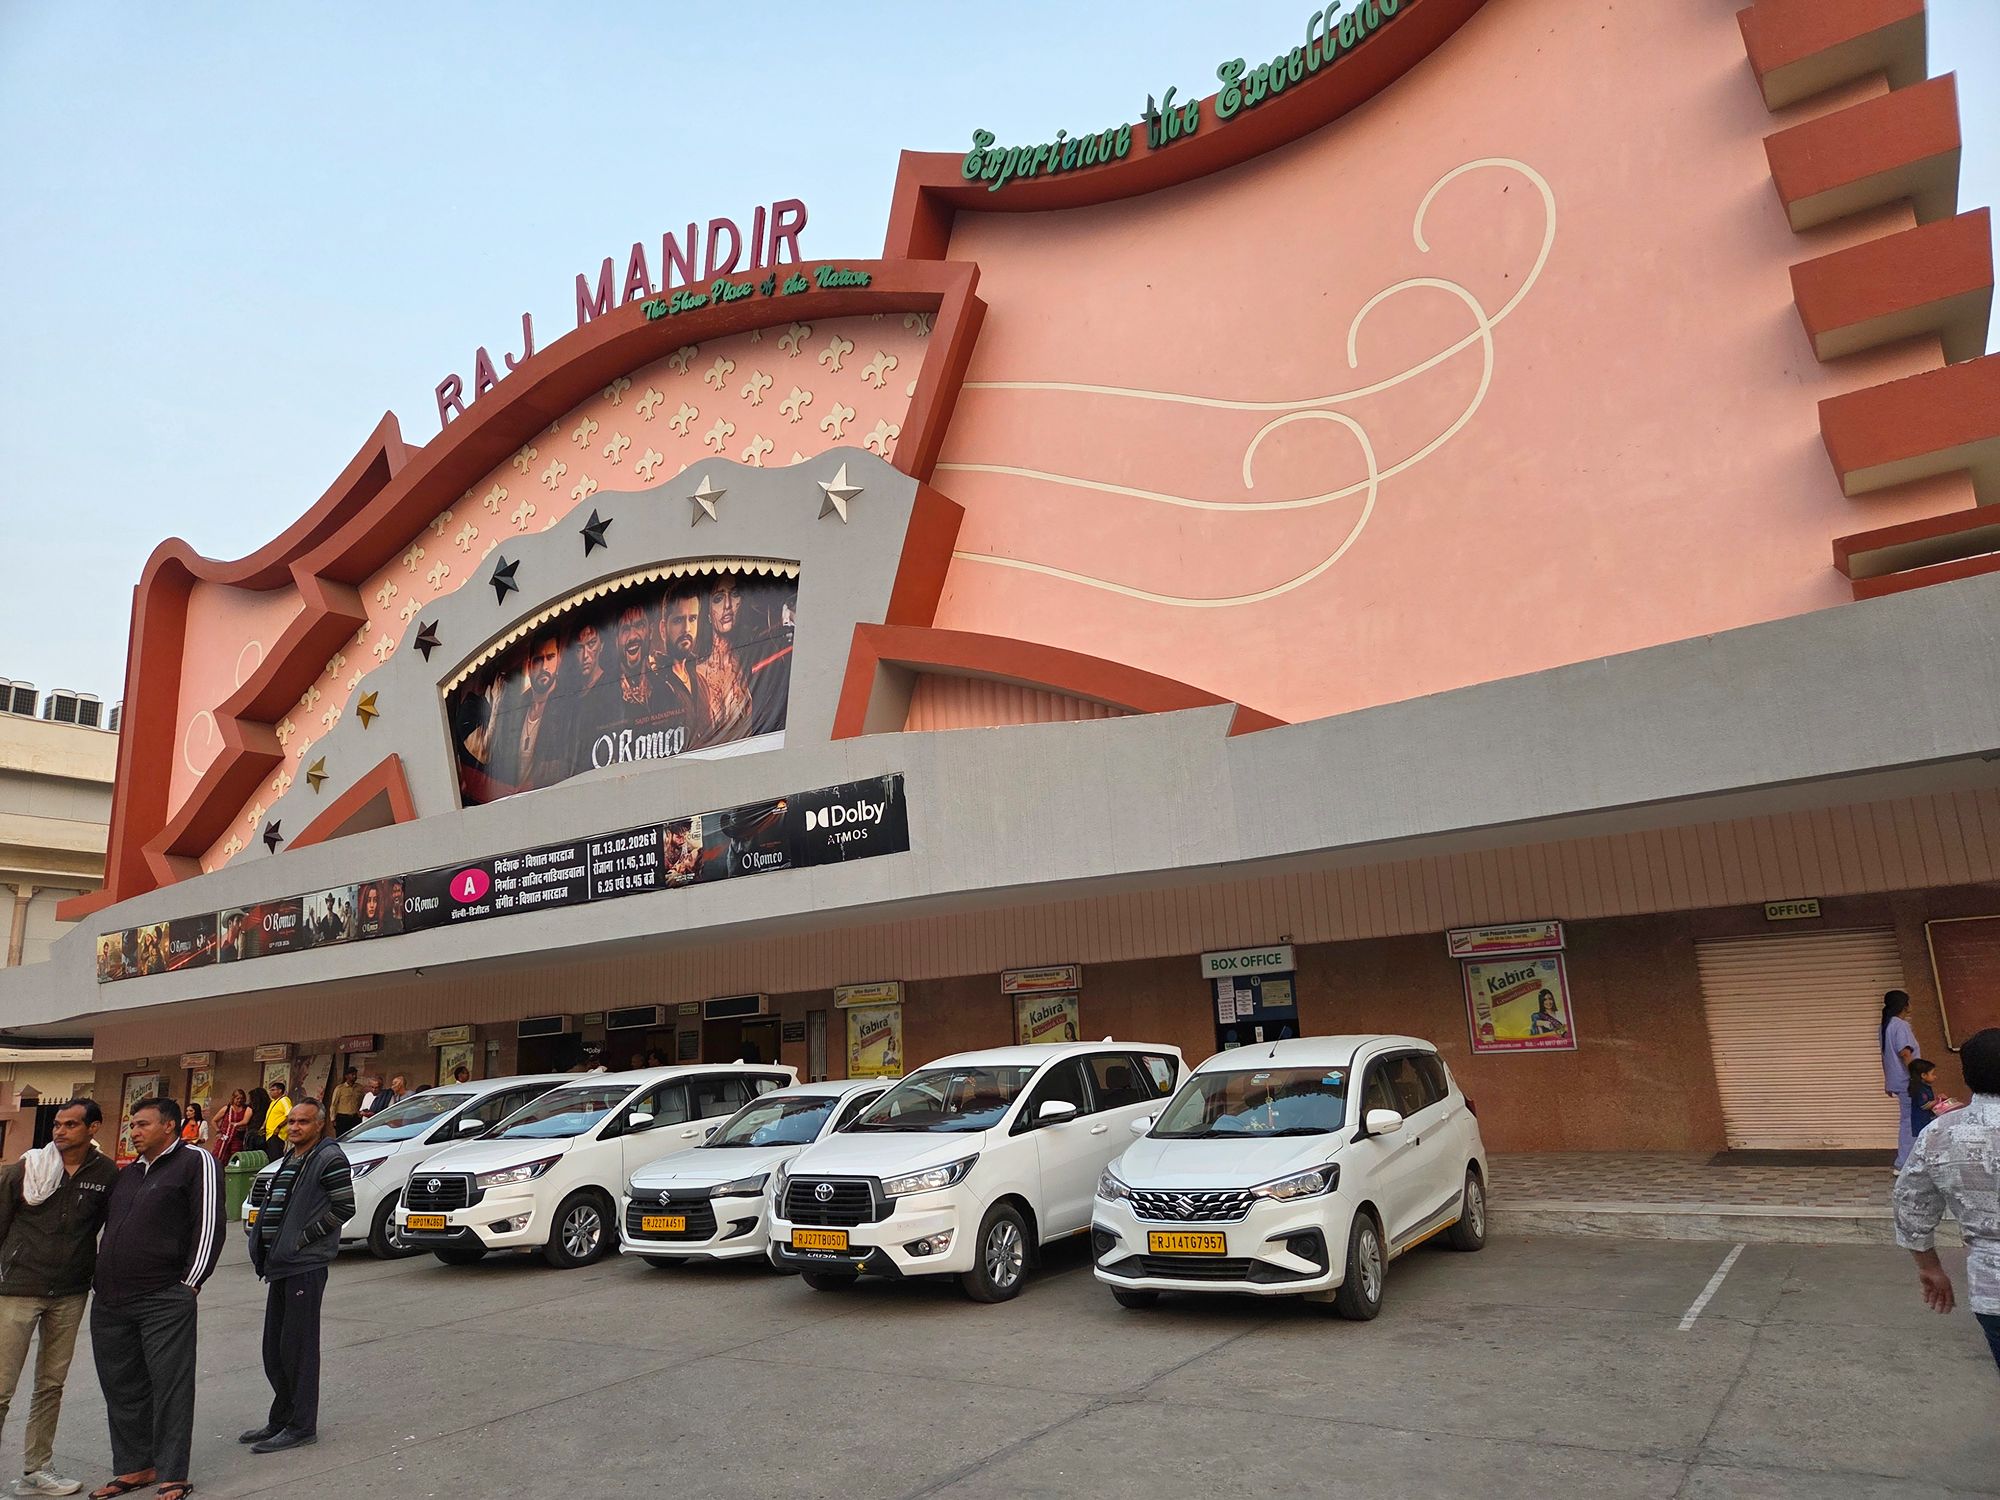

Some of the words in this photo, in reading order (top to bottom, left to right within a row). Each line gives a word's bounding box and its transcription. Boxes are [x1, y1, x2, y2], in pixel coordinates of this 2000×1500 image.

[961, 123, 1132, 192] Experience
[1140, 86, 1200, 149] the
[640, 297, 669, 321] The
[669, 290, 708, 315] Show
[710, 278, 754, 306] Place
[758, 272, 777, 297] of
[782, 273, 809, 297] the
[813, 264, 873, 288] Nation
[435, 313, 535, 431] RAJ
[575, 198, 809, 329] MANDIR
[591, 725, 686, 770] O'Romeo
[831, 799, 886, 827] Dolby
[827, 828, 869, 847] ATMOS
[592, 859, 614, 876] रोजाना
[741, 850, 784, 870] O'Romeo
[463, 876, 476, 896] A
[597, 879, 614, 894] 6.25
[625, 873, 643, 890] 9.45
[404, 892, 440, 914] O'Romeo
[1768, 903, 1817, 917] OFFICE
[263, 911, 297, 932] O'Romeo
[1210, 957, 1238, 970] BOX
[1240, 953, 1282, 968] OFFICE
[1486, 966, 1536, 994] Kabira
[1029, 1003, 1064, 1026] Kabira
[859, 1018, 889, 1039] Kabira
[798, 1233, 846, 1247] RJ27TB0507
[1157, 1236, 1223, 1249] RJ14TG7957
